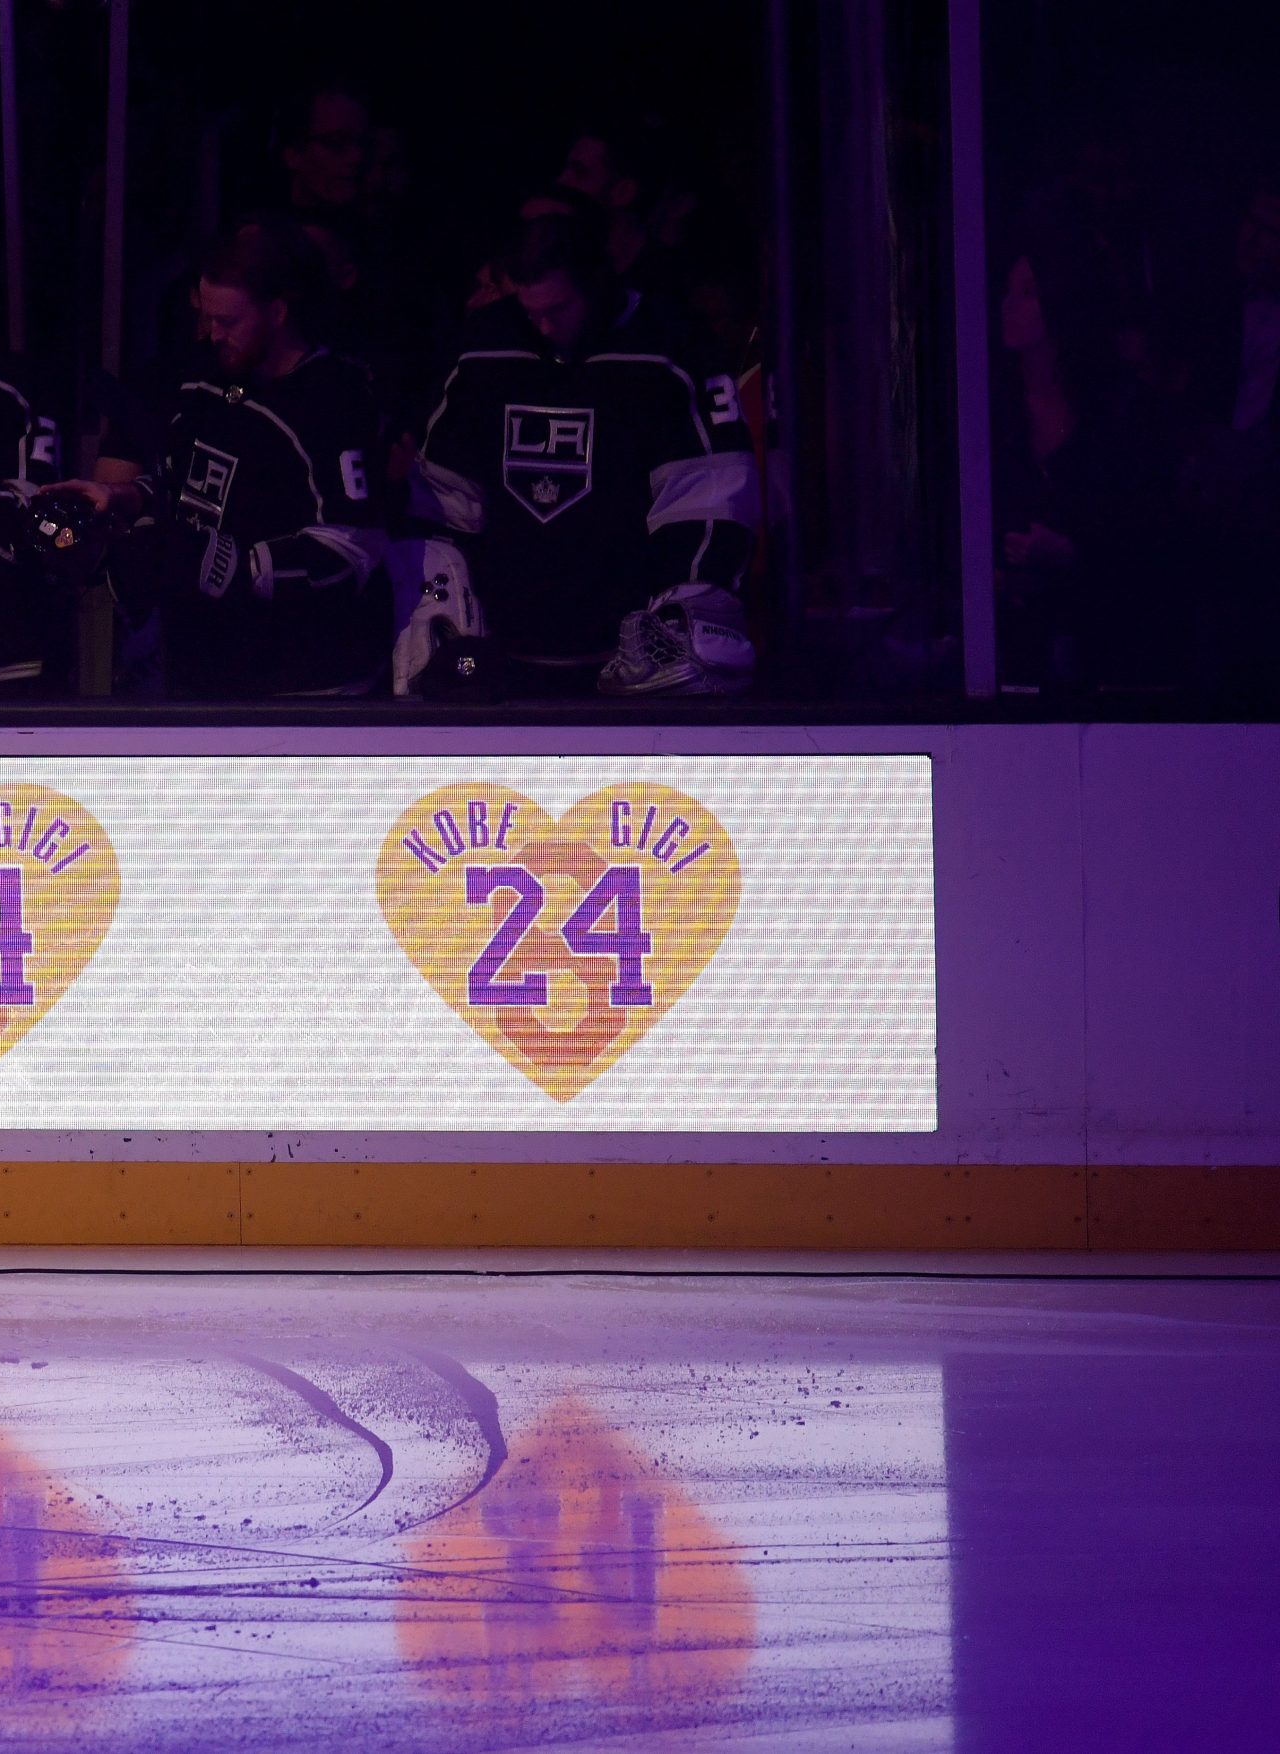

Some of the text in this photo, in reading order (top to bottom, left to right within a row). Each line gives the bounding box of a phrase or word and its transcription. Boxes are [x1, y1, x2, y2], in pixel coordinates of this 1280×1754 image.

[509, 416, 587, 456] LA
[402, 800, 710, 873] KOBE GIGI
[464, 863, 654, 1007] 24
